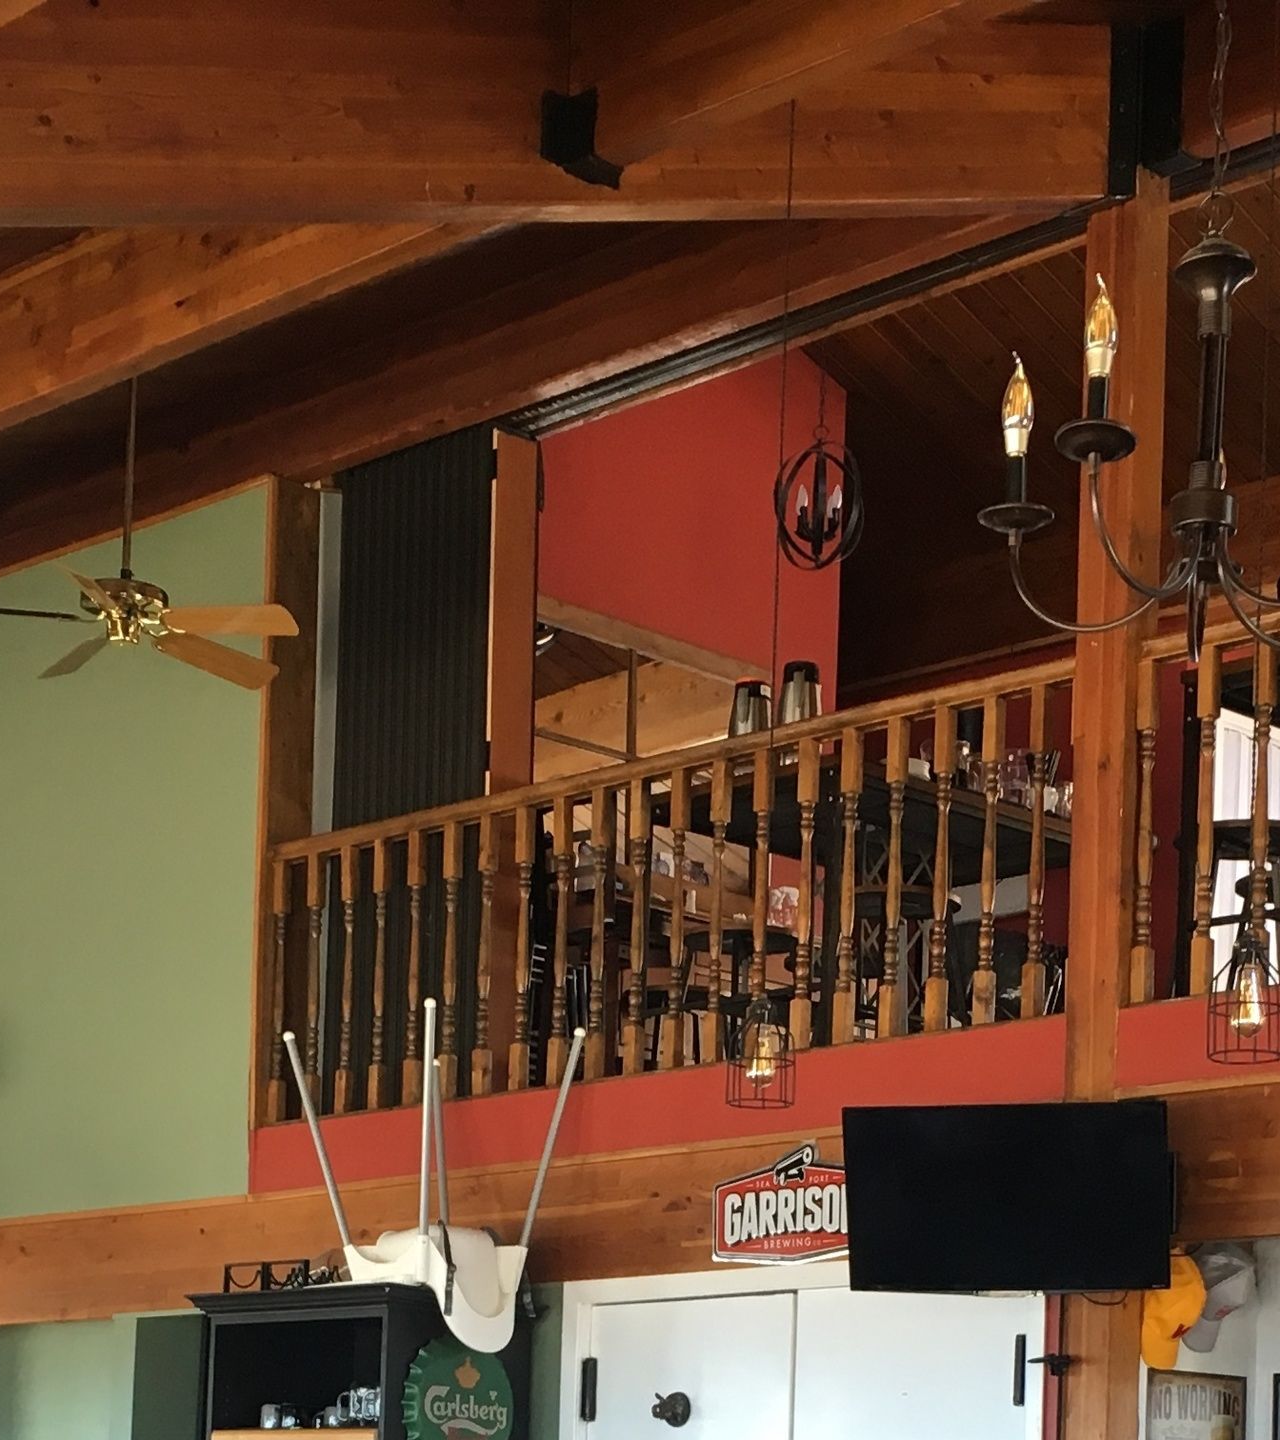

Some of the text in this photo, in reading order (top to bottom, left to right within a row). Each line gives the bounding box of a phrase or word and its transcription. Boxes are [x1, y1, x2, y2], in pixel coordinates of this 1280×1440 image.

[755, 1180, 771, 1188] SEA
[763, 1236, 812, 1250] BREWING
[424, 1385, 508, 1430] Carlsberg
[1153, 1383, 1241, 1427] NO WORKING
